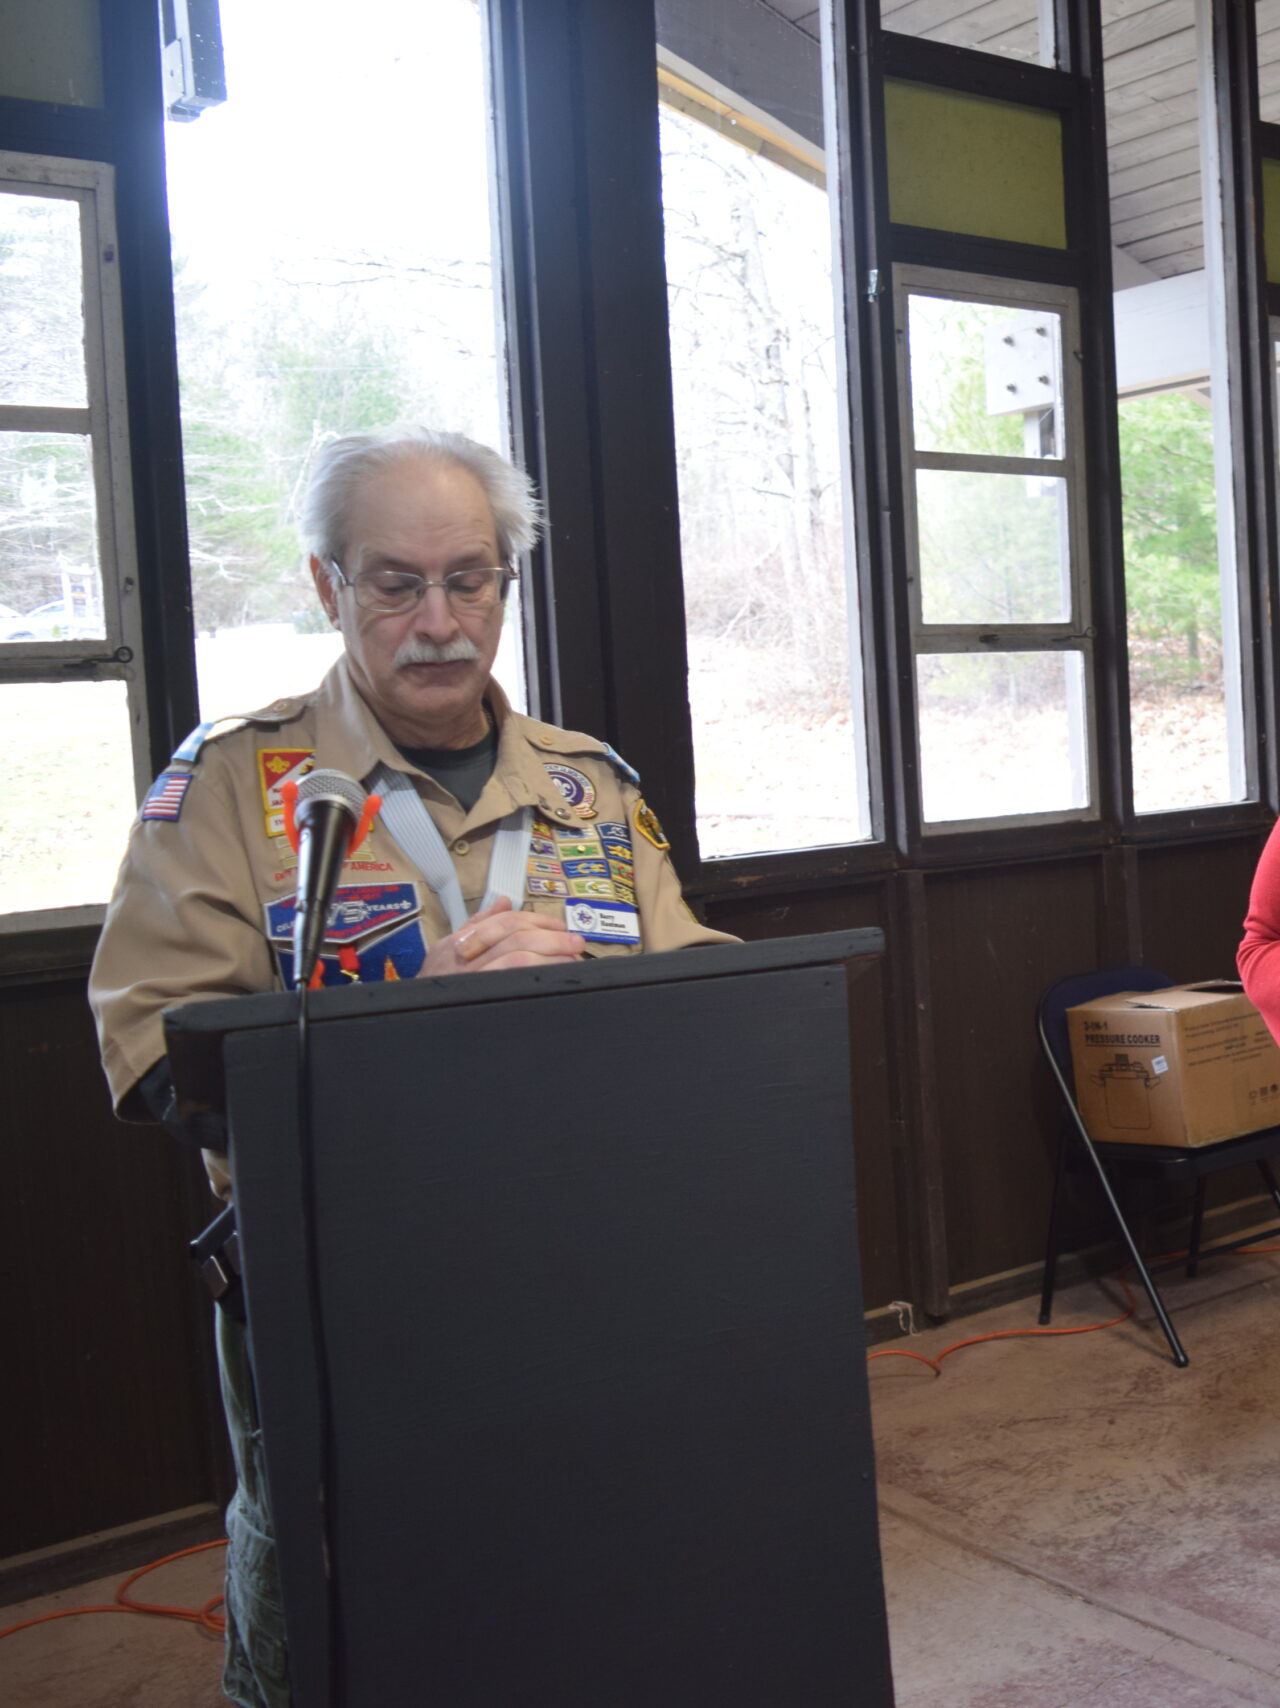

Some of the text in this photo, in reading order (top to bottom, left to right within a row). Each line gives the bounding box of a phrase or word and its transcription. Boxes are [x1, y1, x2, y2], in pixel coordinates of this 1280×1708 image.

[351, 862, 394, 873] AMERICA
[367, 903, 399, 912] YEARS
[1085, 1033, 1160, 1045] PRESSURE COOKER
